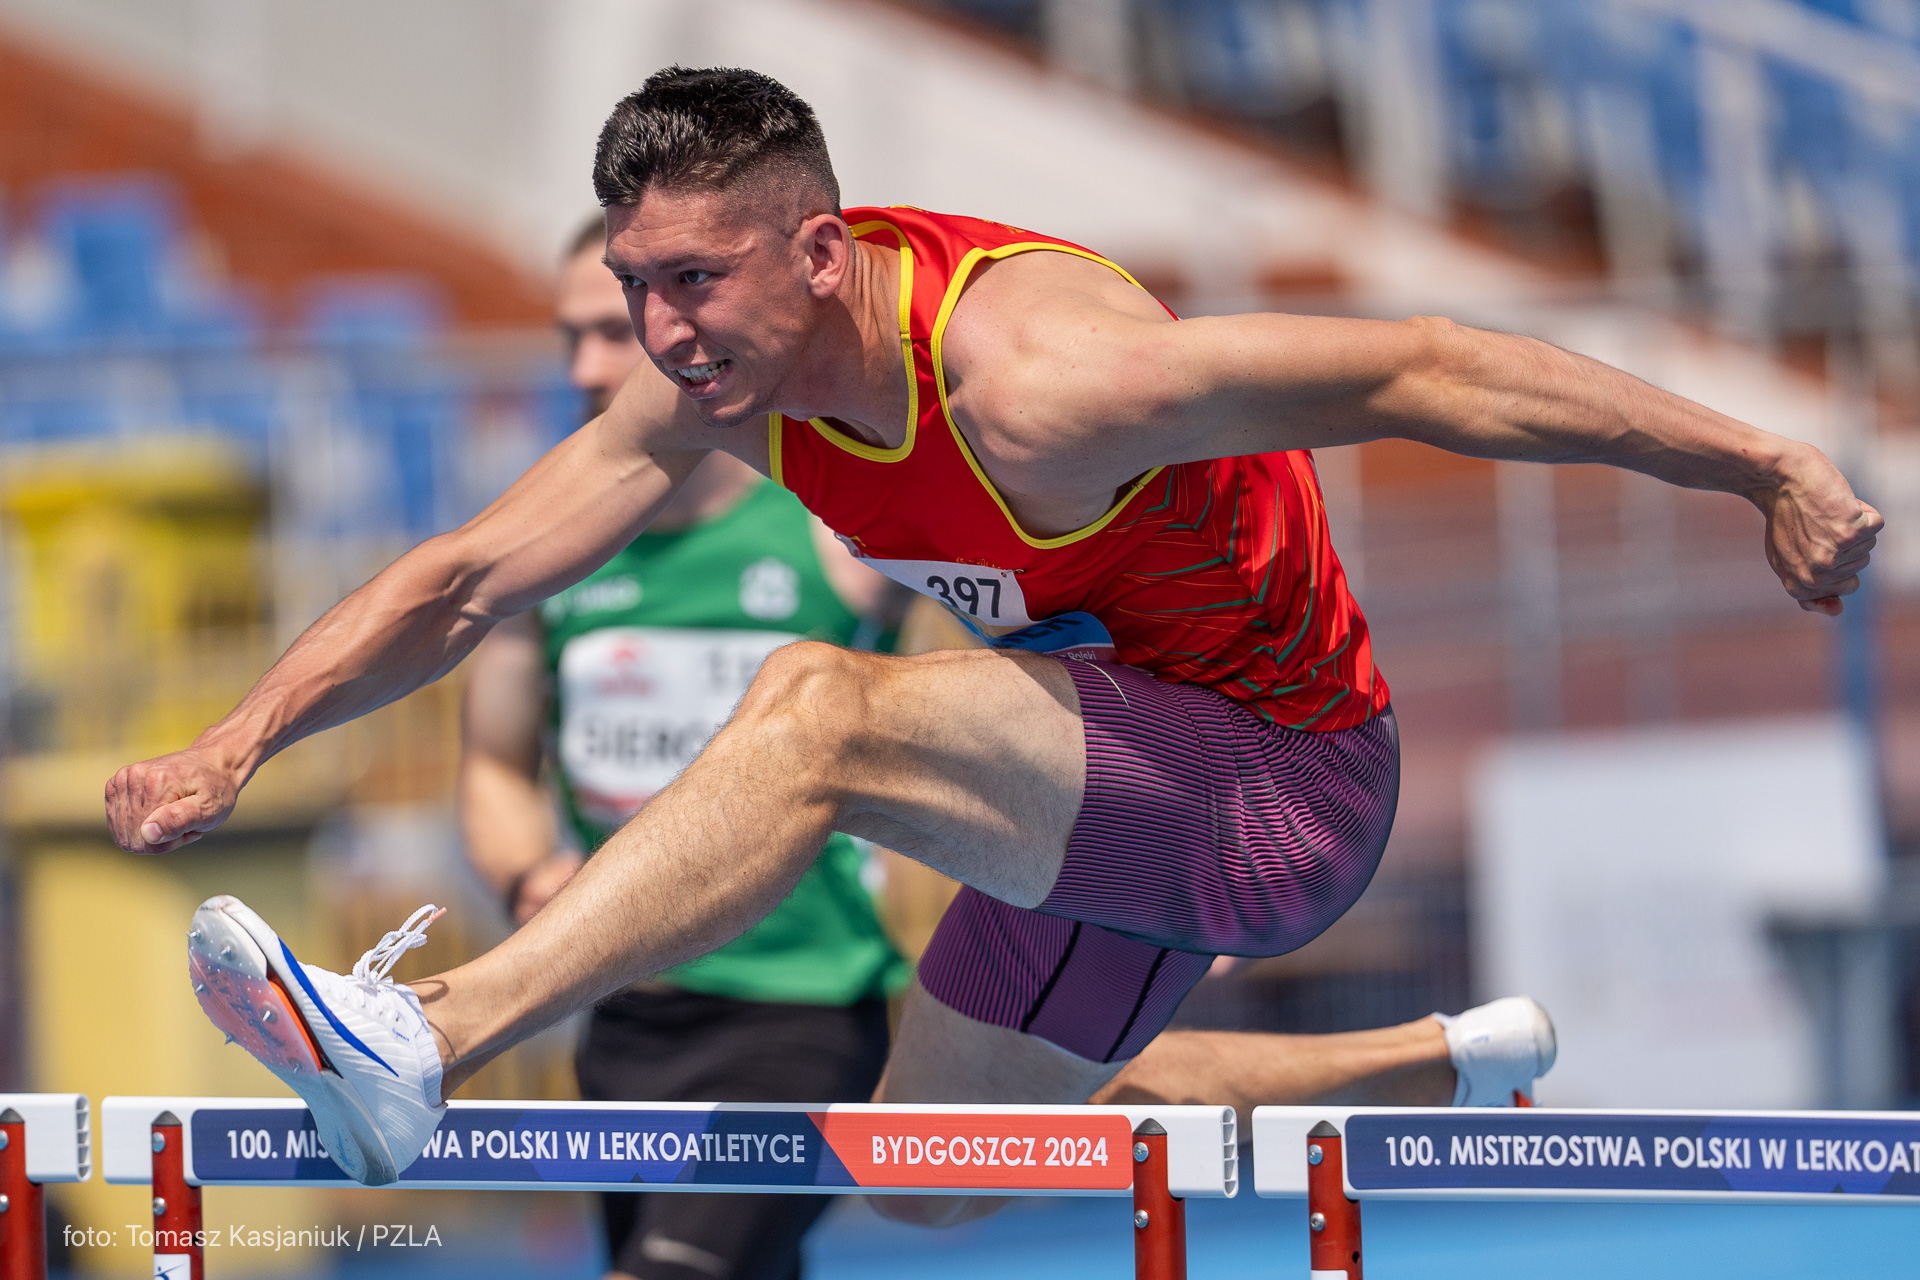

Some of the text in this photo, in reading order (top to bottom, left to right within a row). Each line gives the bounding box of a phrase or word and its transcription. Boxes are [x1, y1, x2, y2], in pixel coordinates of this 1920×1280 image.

[926, 575, 1001, 619] 397
[227, 1129, 278, 1160] 100.
[471, 1129, 558, 1160] POLSKI
[565, 1131, 591, 1160] W
[599, 1131, 806, 1163] LEKKOATLETYCE
[872, 1135, 1109, 1167] BYDGOSZCZ 2024
[1385, 1135, 1441, 1167] 100.
[1449, 1134, 1646, 1168] MISTRZOSTWA
[1654, 1136, 1751, 1169] POLSKI
[1759, 1138, 1788, 1170] W
